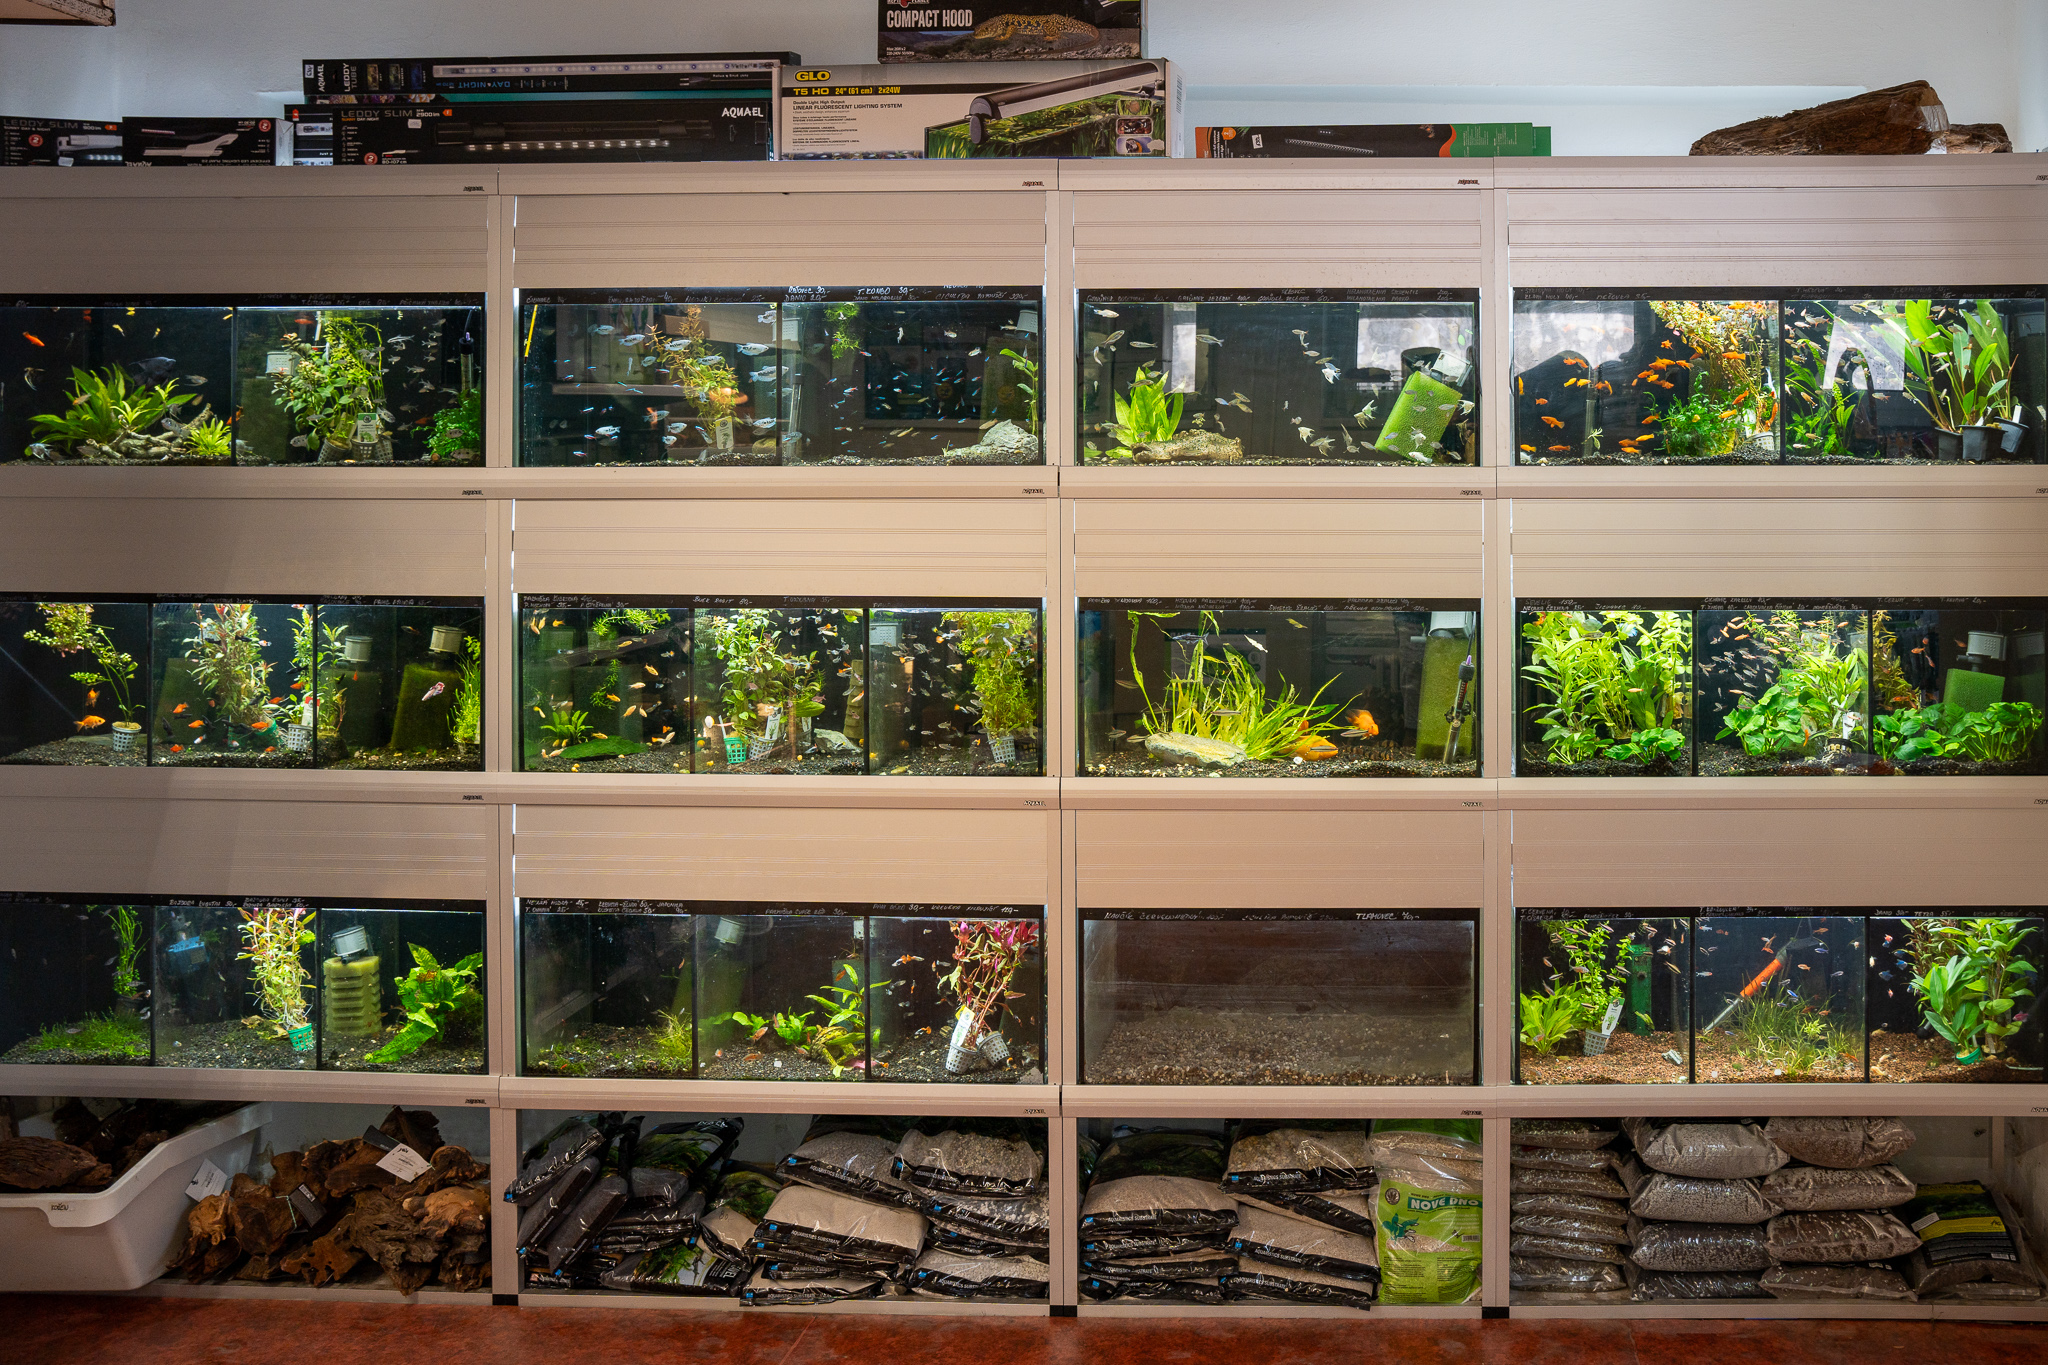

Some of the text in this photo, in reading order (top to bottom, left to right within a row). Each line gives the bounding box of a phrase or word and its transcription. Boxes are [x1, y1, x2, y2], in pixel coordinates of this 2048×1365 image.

[886, 9, 973, 28] COMPACT HOOD
[317, 64, 325, 92] AQUAEL
[342, 63, 350, 92] LEDDY
[350, 66, 358, 89] TUBE
[796, 71, 830, 81] GLO
[878, 86, 901, 94] 2x24W
[721, 107, 764, 118] AQUAEL
[3, 119, 78, 129] LEDDY SLIM
[1449, 1197, 1479, 1206] DNO
